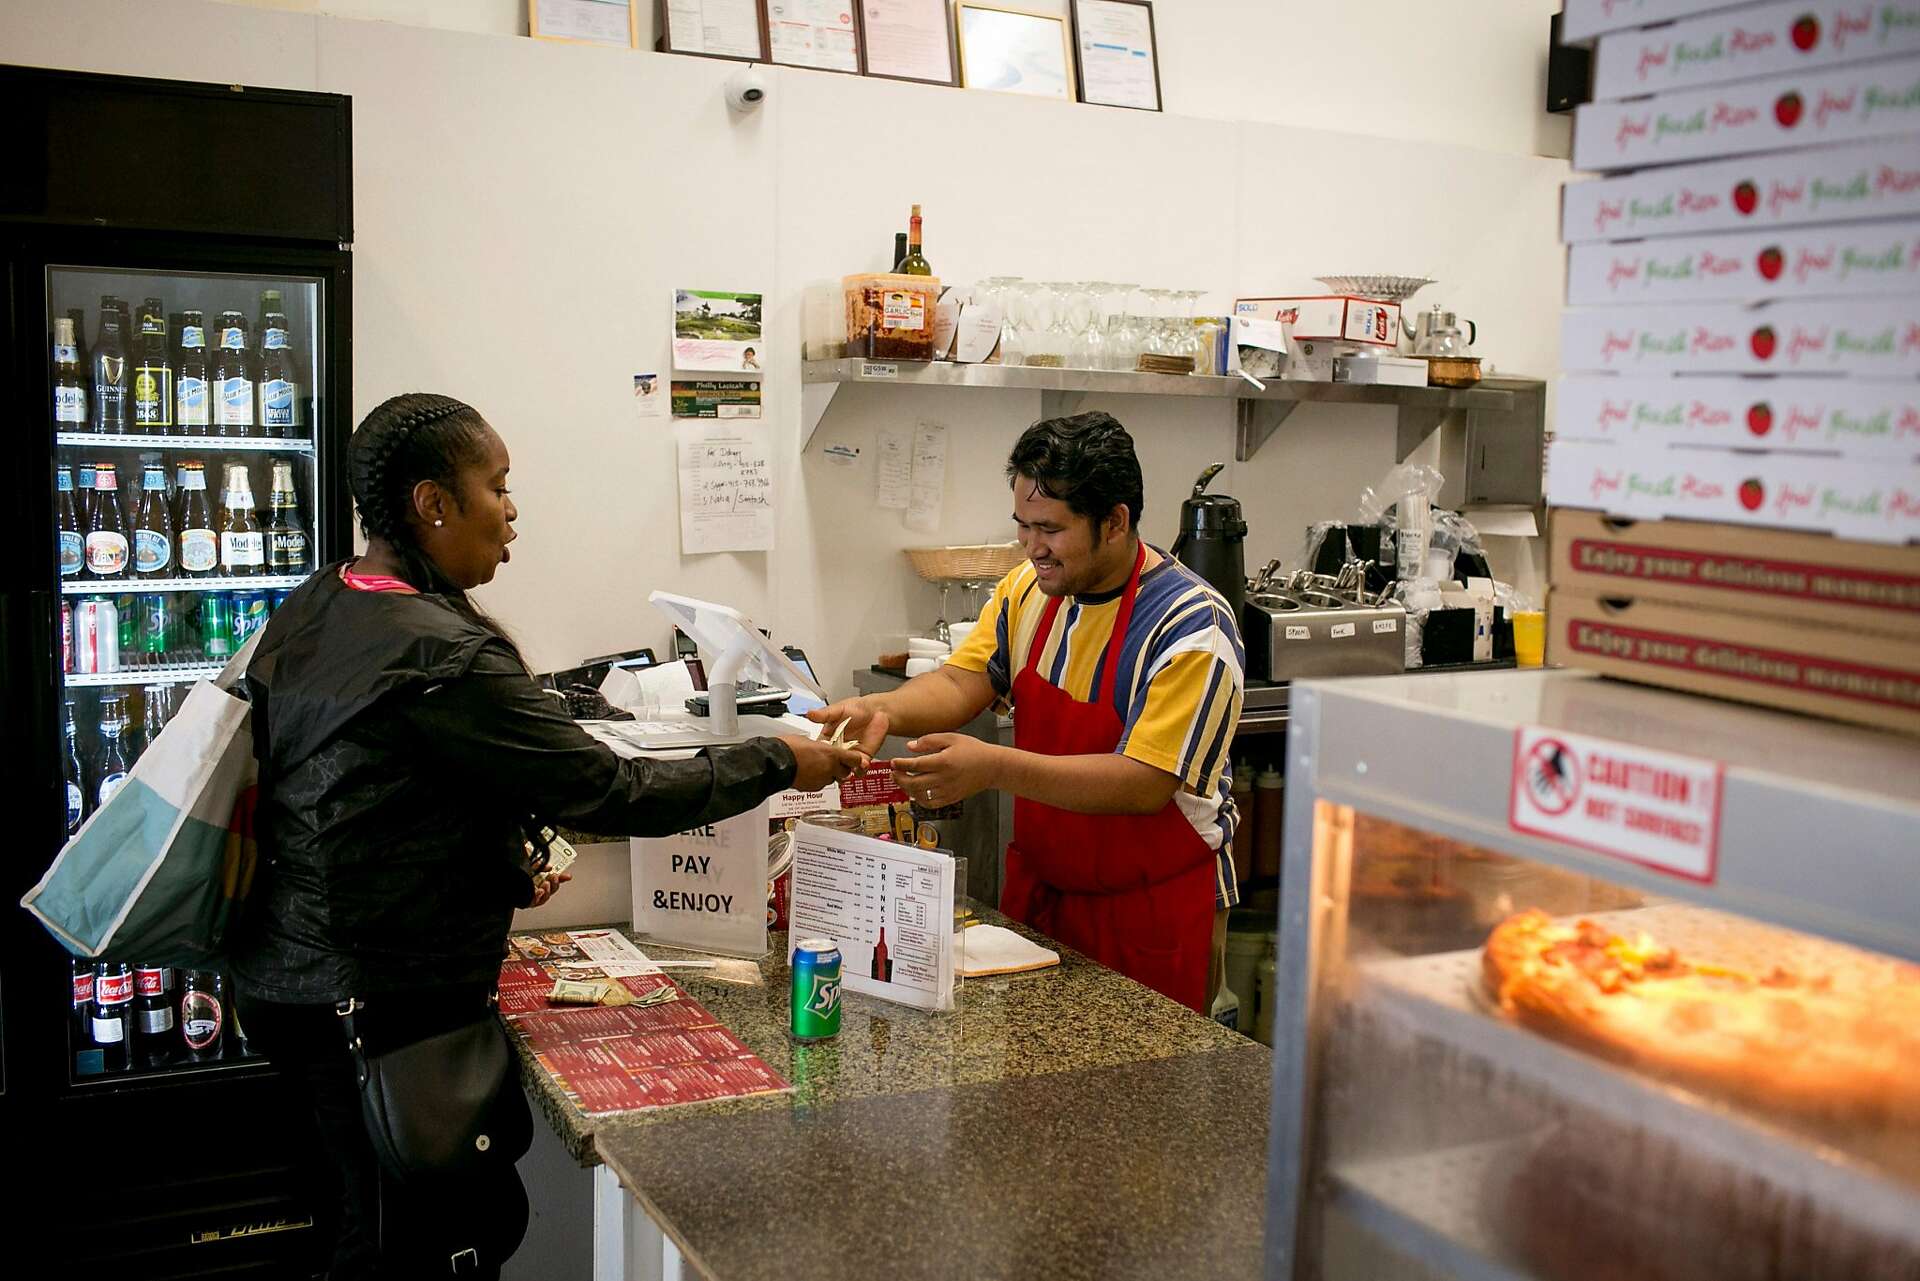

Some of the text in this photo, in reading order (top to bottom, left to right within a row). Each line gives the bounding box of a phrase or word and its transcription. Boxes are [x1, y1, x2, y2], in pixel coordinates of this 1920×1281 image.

[1588, 754, 1691, 803] CAUTION
[782, 794, 805, 802] Happy
[671, 854, 711, 875] PAY
[653, 889, 733, 913] &ENJOY
